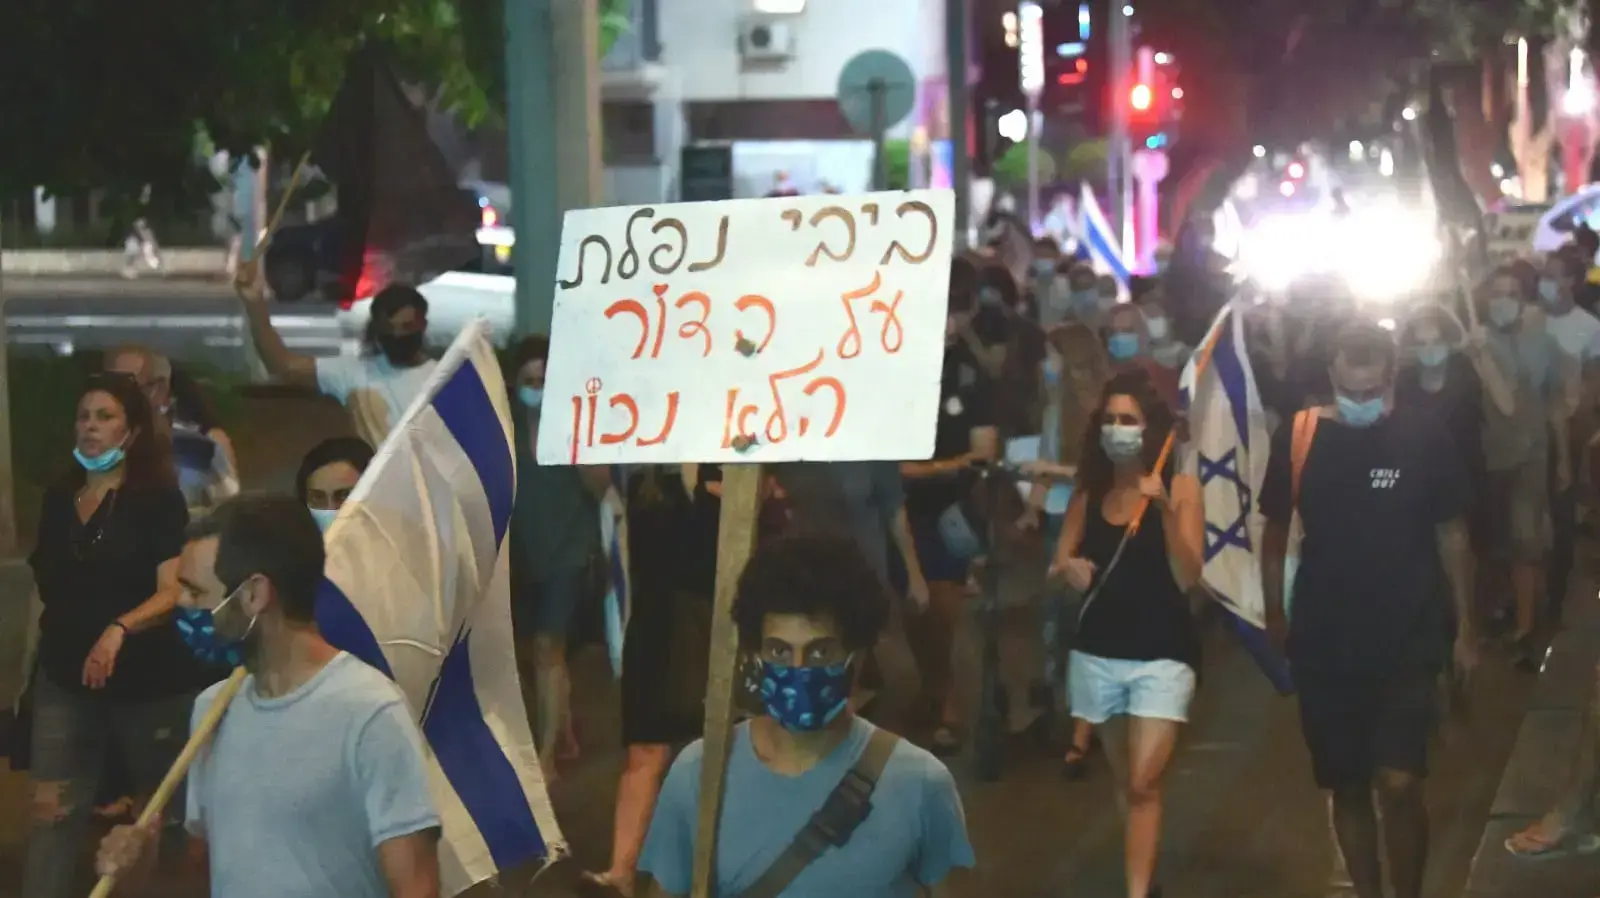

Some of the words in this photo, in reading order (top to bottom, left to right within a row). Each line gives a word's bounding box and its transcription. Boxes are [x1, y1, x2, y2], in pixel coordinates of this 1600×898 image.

[561, 208, 729, 289] נפלת
[781, 201, 937, 266] ביבי
[604, 284, 776, 358] הדור
[836, 271, 904, 359] על
[571, 377, 679, 464] נכון
[720, 348, 847, 452] הלא
[1370, 468, 1400, 478] CHILL
[1372, 479, 1395, 488] OUT
